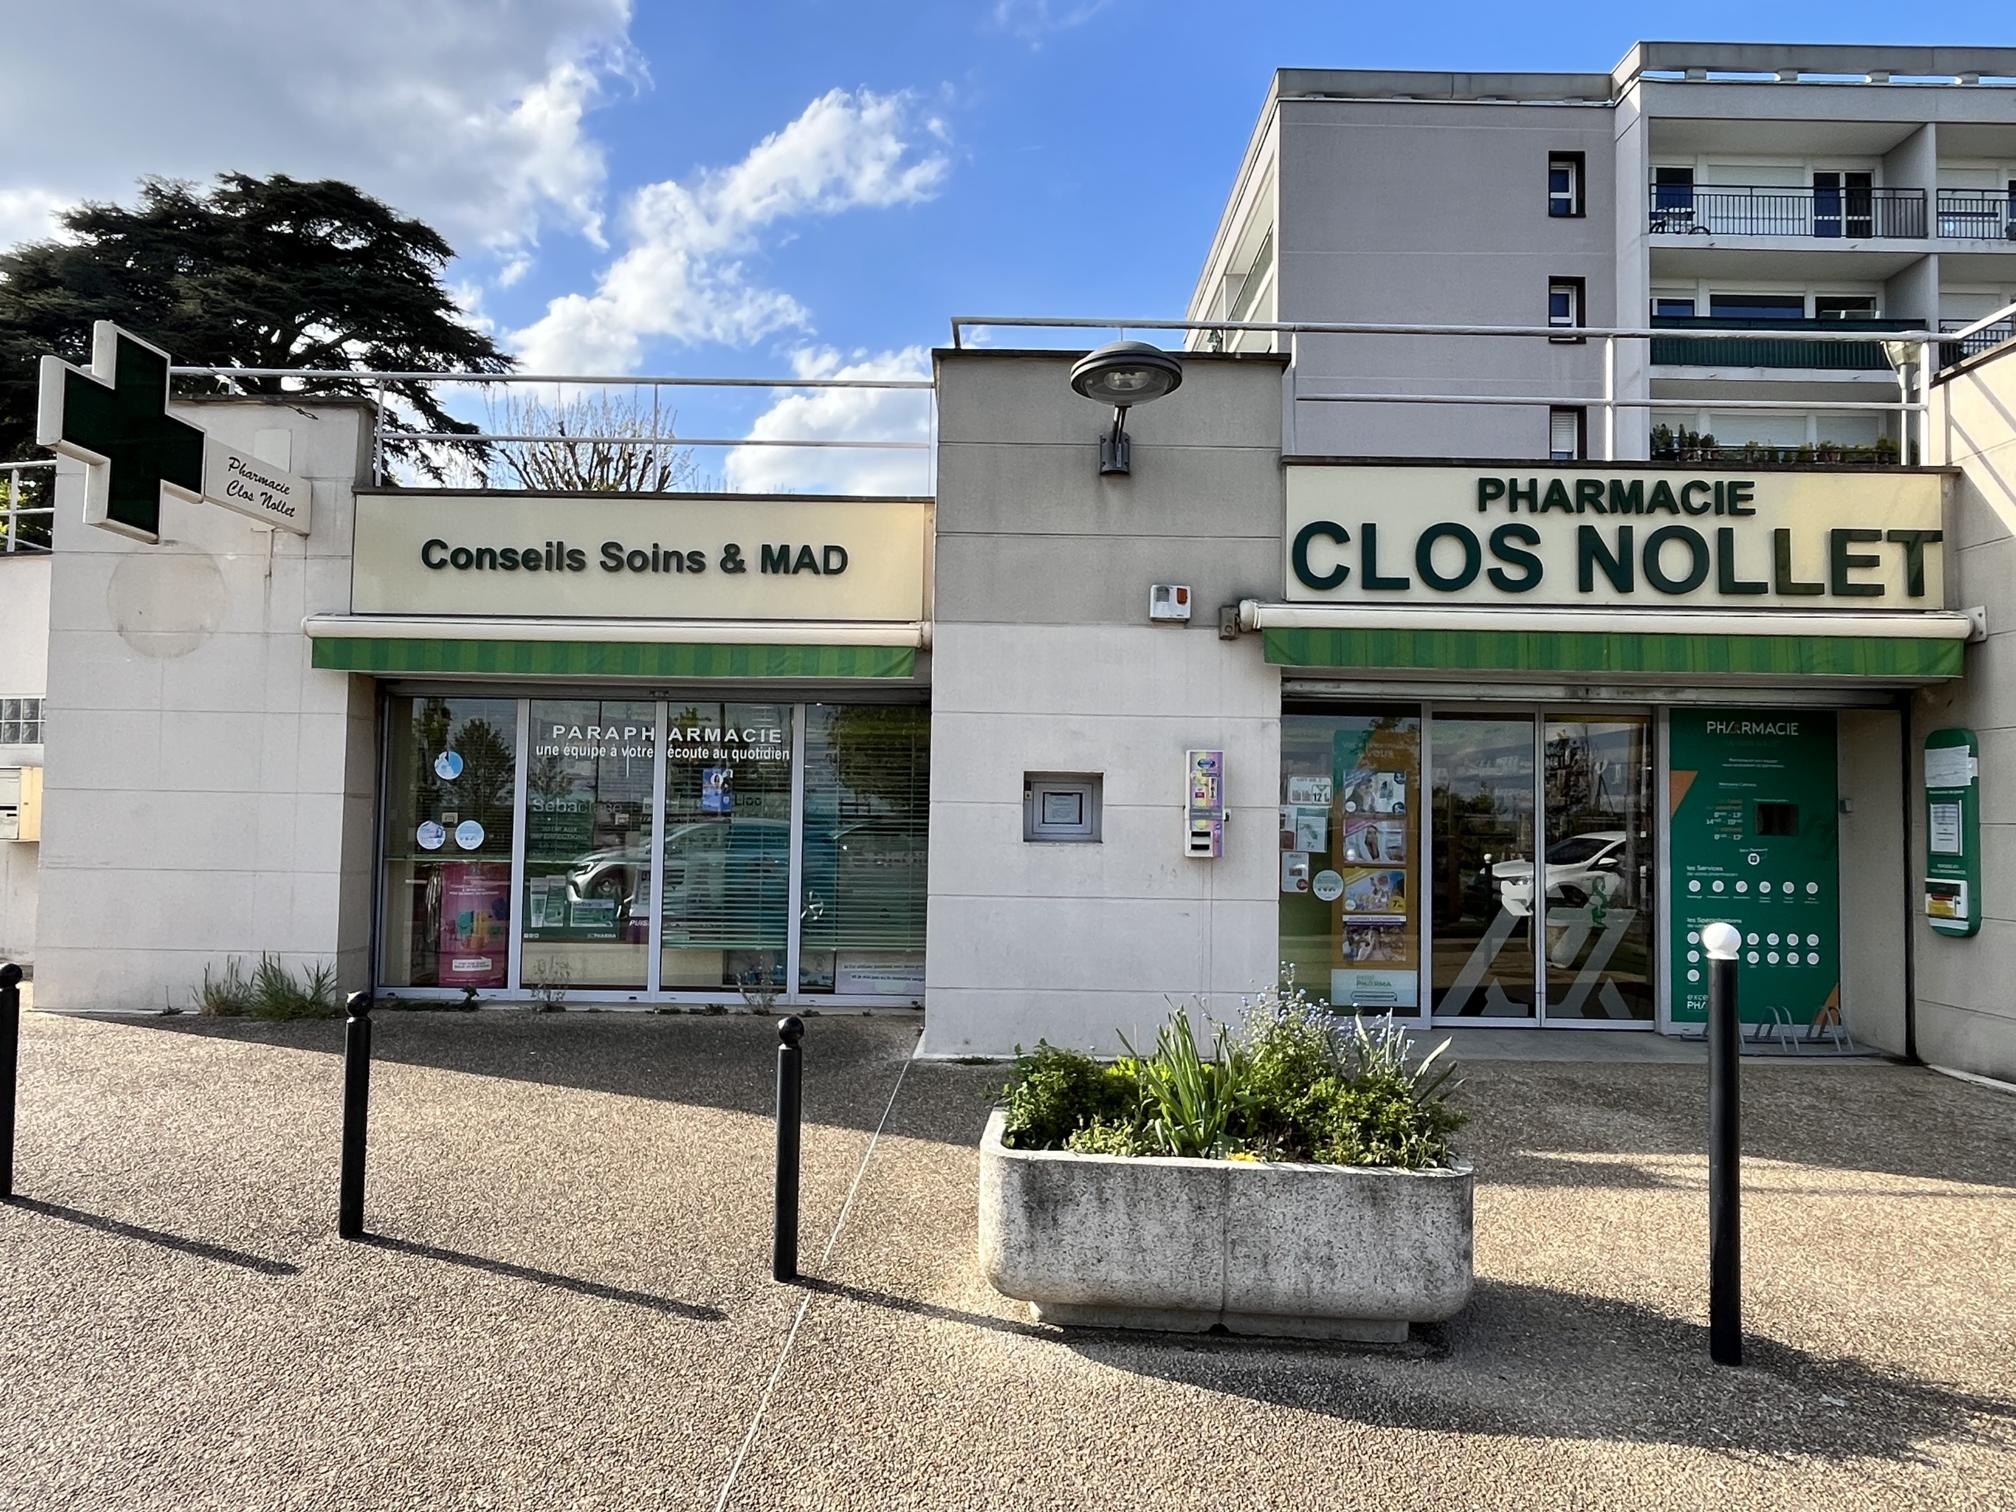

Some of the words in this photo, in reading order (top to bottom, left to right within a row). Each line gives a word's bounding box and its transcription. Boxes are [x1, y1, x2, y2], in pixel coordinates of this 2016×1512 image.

[227, 456, 291, 495] Pharmacie
[226, 479, 255, 502] Clos
[260, 491, 296, 518] Nollet
[1477, 477, 1757, 516] PHARMACIE
[421, 538, 587, 572] Conseils
[599, 541, 707, 574] Soins
[719, 543, 747, 575] &
[760, 543, 849, 576] MAD
[1291, 520, 1544, 593] CLOS
[1577, 523, 1944, 598] NOLLET
[552, 724, 783, 744] PARAPHARMACIE
[1706, 721, 1800, 736] PHARMACIE
[536, 745, 559, 756] une
[563, 744, 607, 761] équipe
[610, 744, 618, 757] à
[621, 746, 654, 758] votre
[667, 744, 709, 759] écoute
[713, 749, 728, 760] au
[731, 746, 790, 763] quotidien
